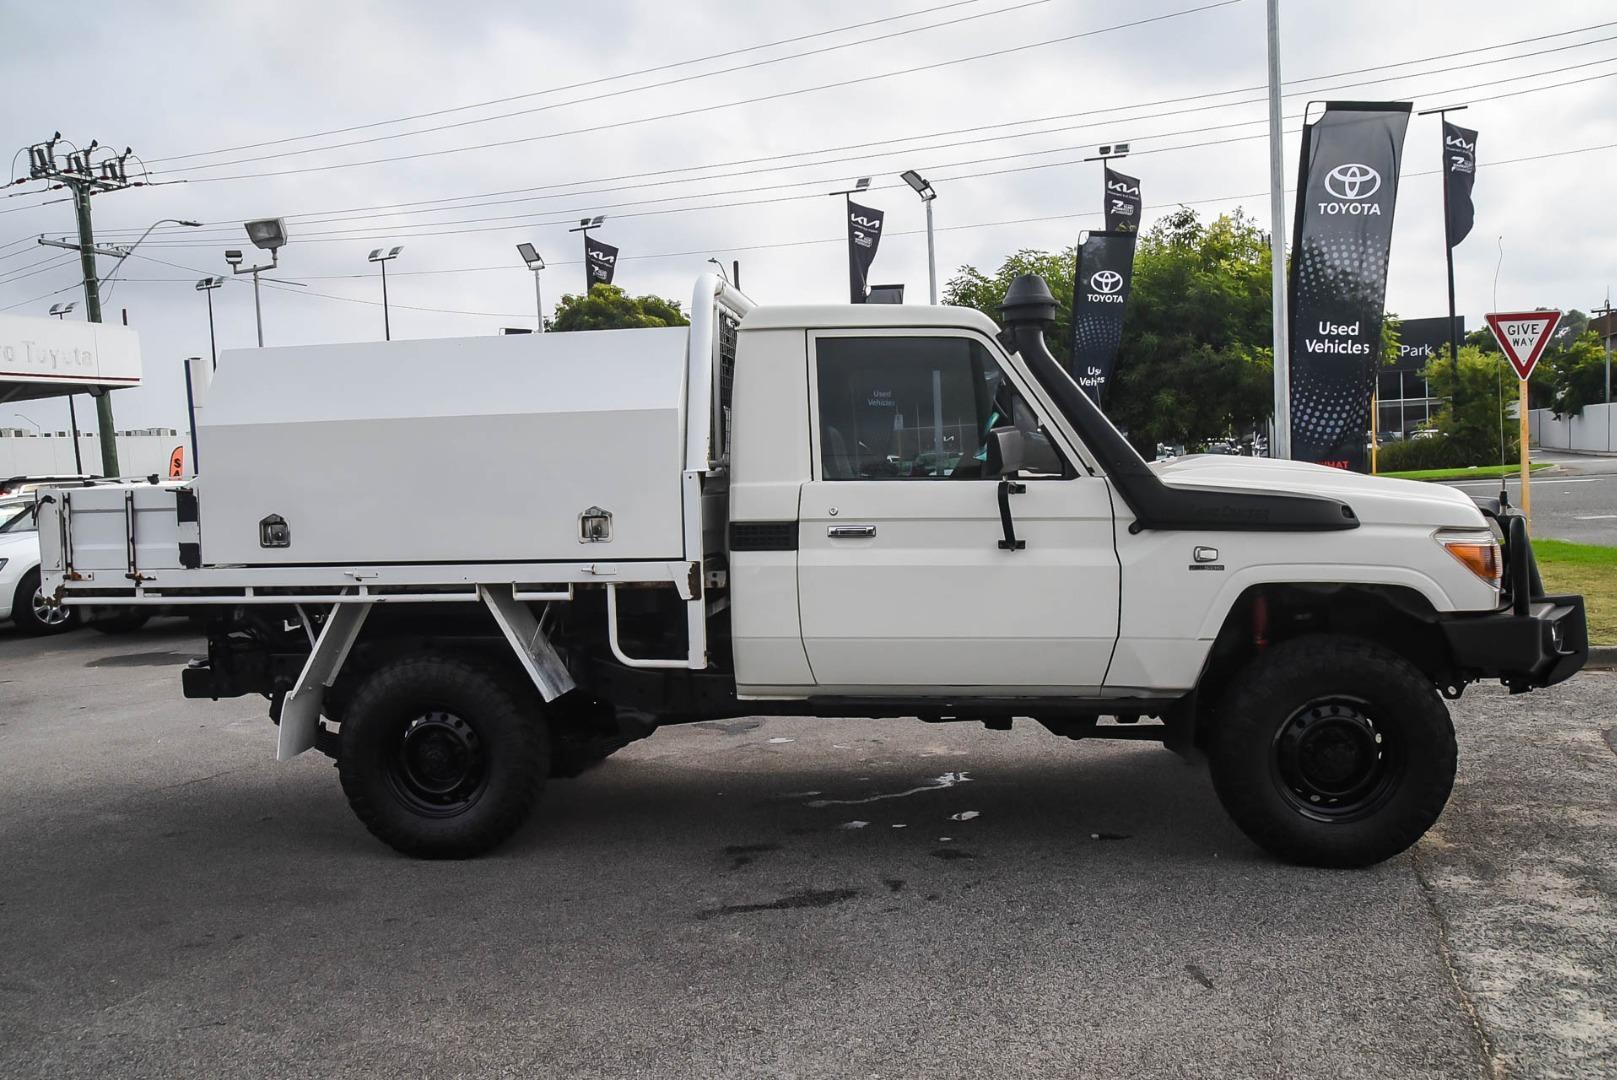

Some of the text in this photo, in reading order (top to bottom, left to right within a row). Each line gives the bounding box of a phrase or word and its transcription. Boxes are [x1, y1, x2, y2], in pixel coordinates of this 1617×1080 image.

[1318, 202, 1381, 216] TOYOTA
[1087, 294, 1123, 303] TOYOTA
[1319, 321, 1359, 336] Used
[1507, 323, 1540, 336] GIVE
[1305, 339, 1370, 355] Vehicles
[1512, 338, 1535, 347] WAY
[1400, 344, 1433, 357] Park
